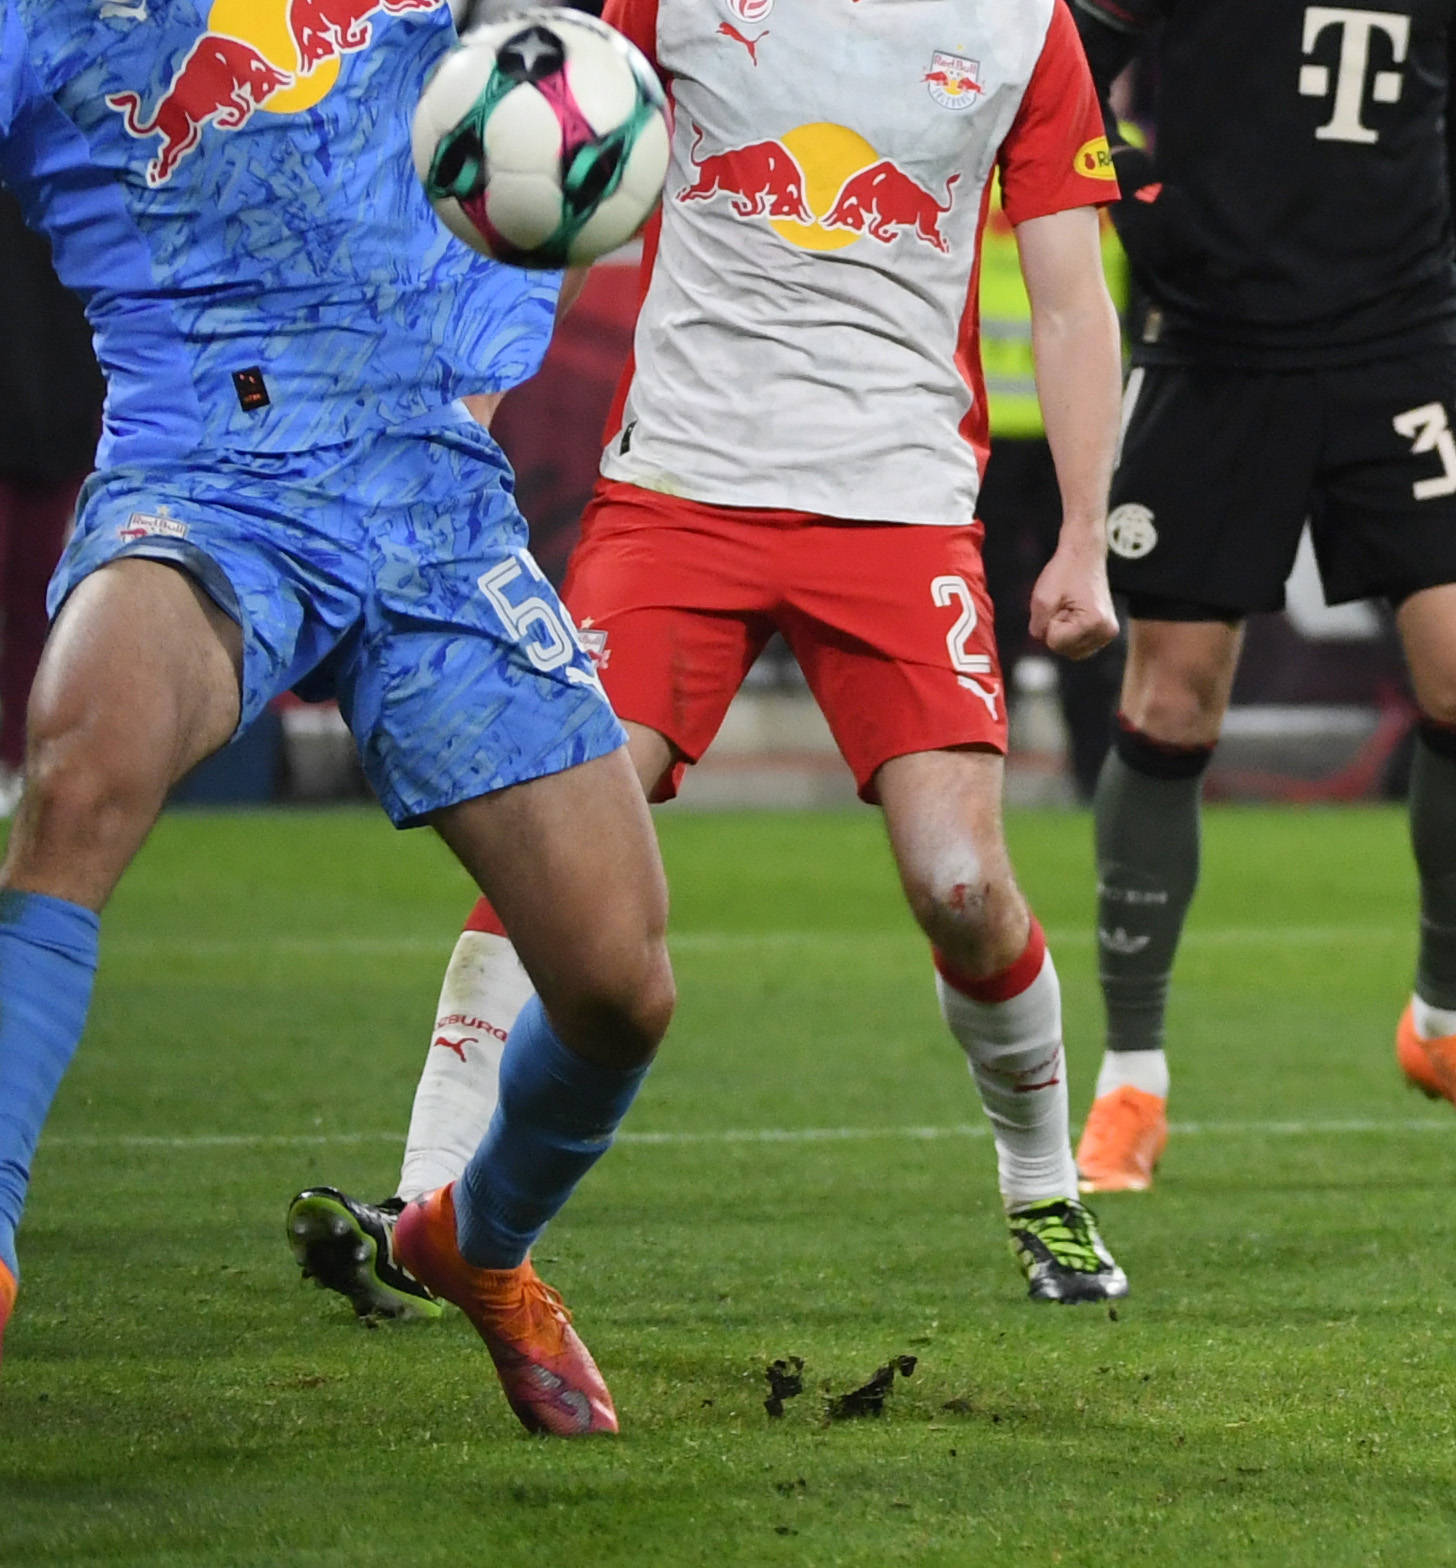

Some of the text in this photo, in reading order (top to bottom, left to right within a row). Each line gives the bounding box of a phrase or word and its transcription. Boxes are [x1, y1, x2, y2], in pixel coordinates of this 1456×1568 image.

[1299, 6, 1411, 145] T
[930, 575, 991, 674] 2
[438, 1013, 508, 1043] ZBURG
